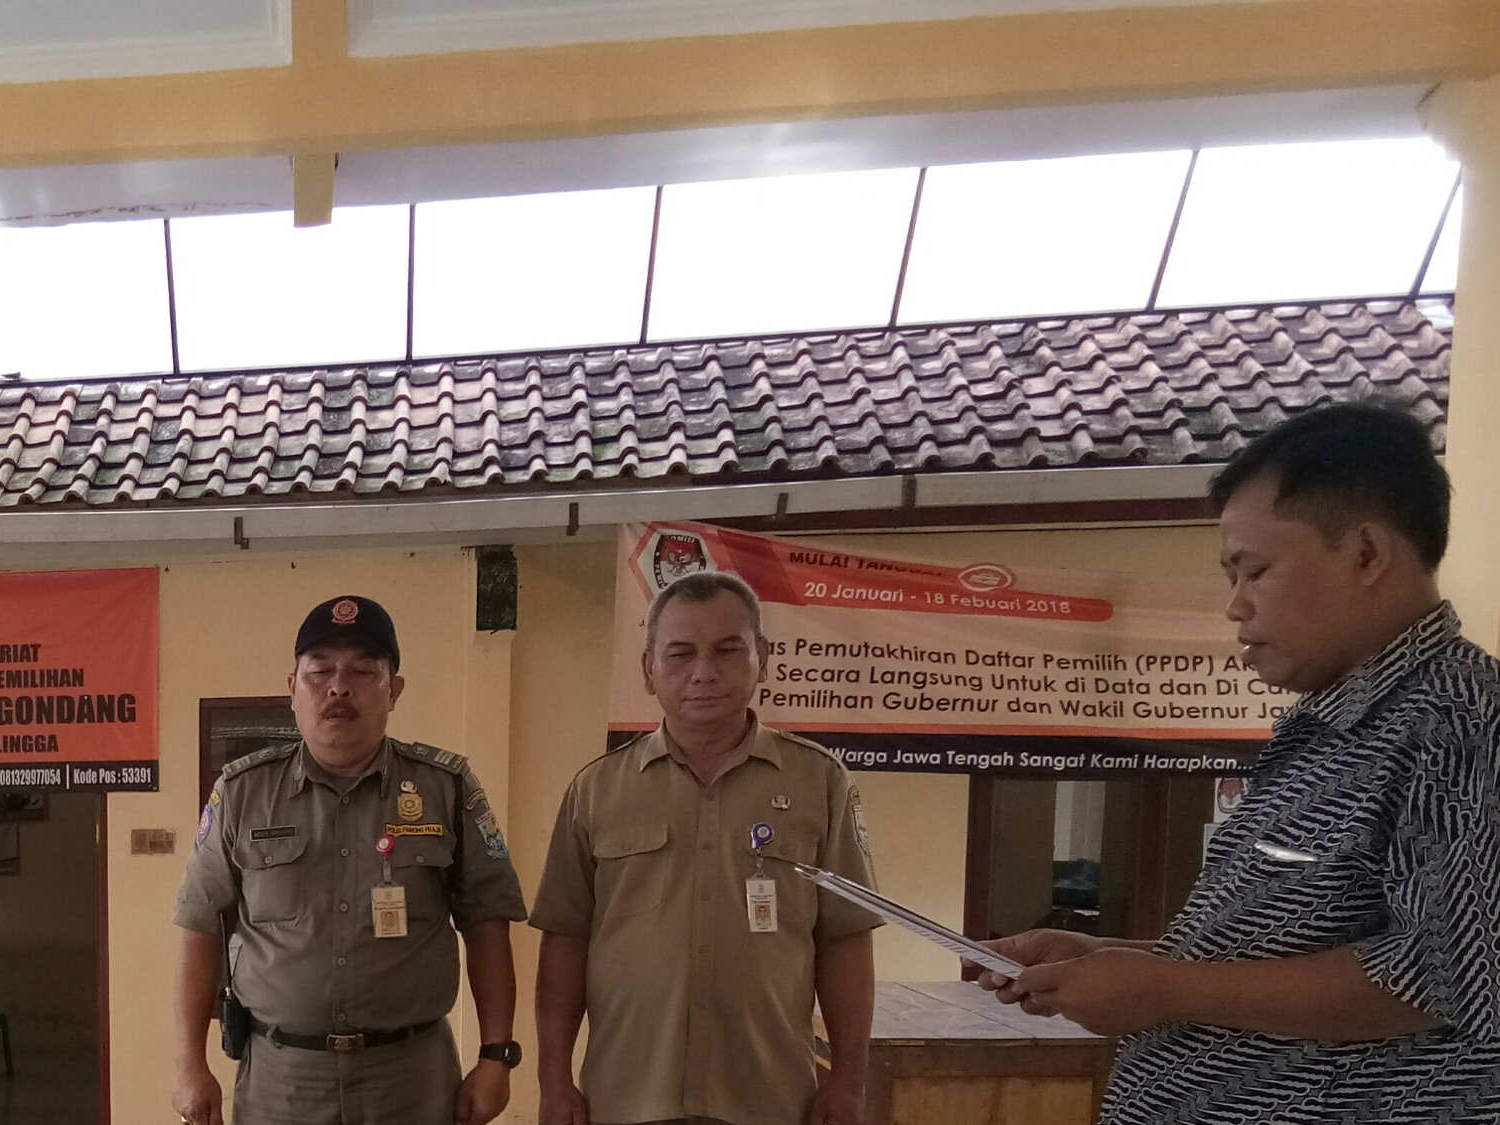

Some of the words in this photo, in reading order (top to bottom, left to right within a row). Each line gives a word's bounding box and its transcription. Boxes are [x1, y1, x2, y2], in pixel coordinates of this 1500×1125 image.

[790, 552, 849, 568] MULAI
[804, 582, 827, 597] 20
[831, 584, 904, 602] Januari
[924, 592, 944, 605] 18
[950, 594, 1021, 610] Febuari
[1026, 600, 1071, 614] 2018
[795, 638, 956, 665] Pemutakhiran
[965, 649, 1035, 669] Daftar
[1043, 653, 1127, 671] Pemilih
[1135, 654, 1214, 676] (PPDP)
[776, 663, 860, 684] Secara
[869, 666, 983, 691] Langsung
[991, 674, 1057, 692] Untuk
[1065, 677, 1086, 693] di
[1094, 678, 1151, 694] Data
[1160, 679, 1207, 695] dan
[1216, 678, 1238, 695] Di
[759, 688, 873, 709] Pemilihan
[882, 692, 999, 713] Gubernur
[1007, 697, 1052, 714] dan
[1060, 700, 1124, 718] Wakil
[1133, 701, 1248, 719] Gubernur
[829, 747, 887, 766] Warga
[893, 750, 941, 764] Jawa
[946, 750, 1014, 769] Tengah
[1019, 752, 1085, 771] Sangat
[1090, 753, 1139, 769] Kami
[0, 768, 61, 785] 081329977054
[73, 768, 97, 784] Kode
[121, 767, 151, 784] 53391
